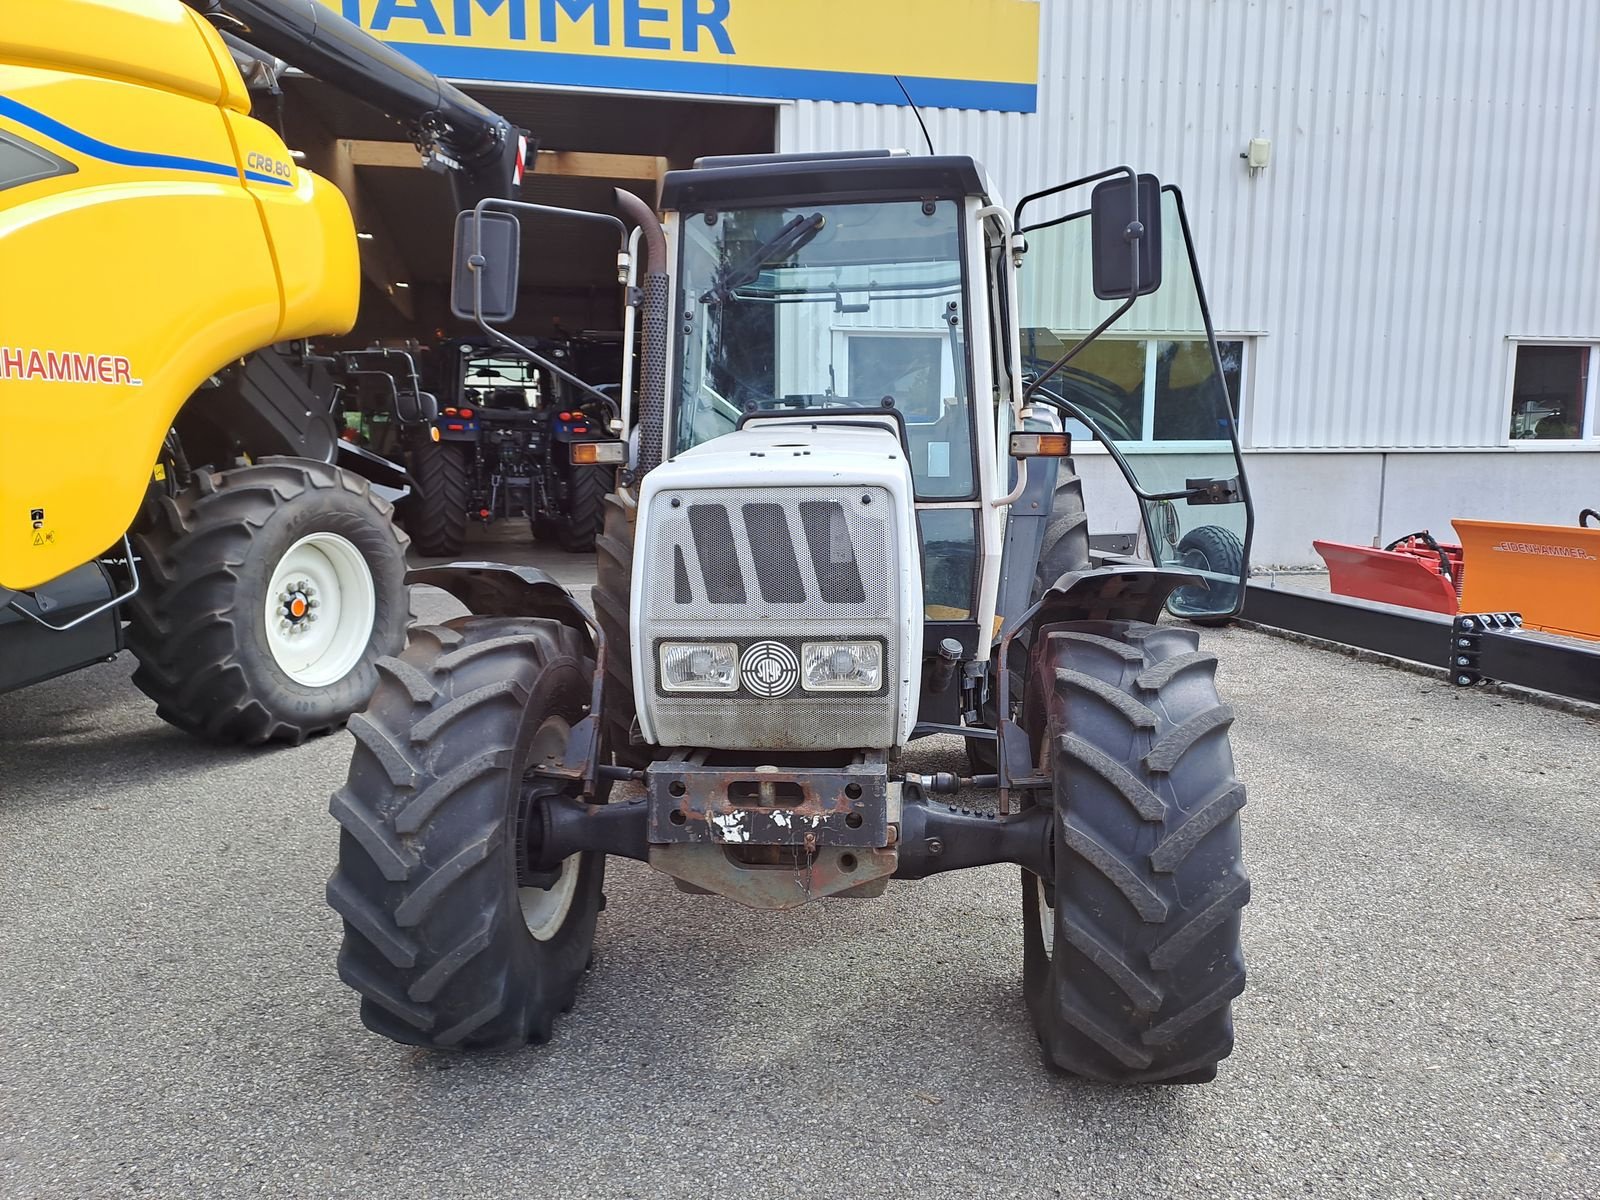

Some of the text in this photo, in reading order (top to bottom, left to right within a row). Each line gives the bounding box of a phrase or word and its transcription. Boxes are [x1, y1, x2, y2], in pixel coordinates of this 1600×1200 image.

[340, 0, 737, 54] AMMER
[247, 152, 291, 178] CR8.80
[0, 348, 131, 383] HAMMER
[1500, 542, 1587, 559] EIDENHAMMER
